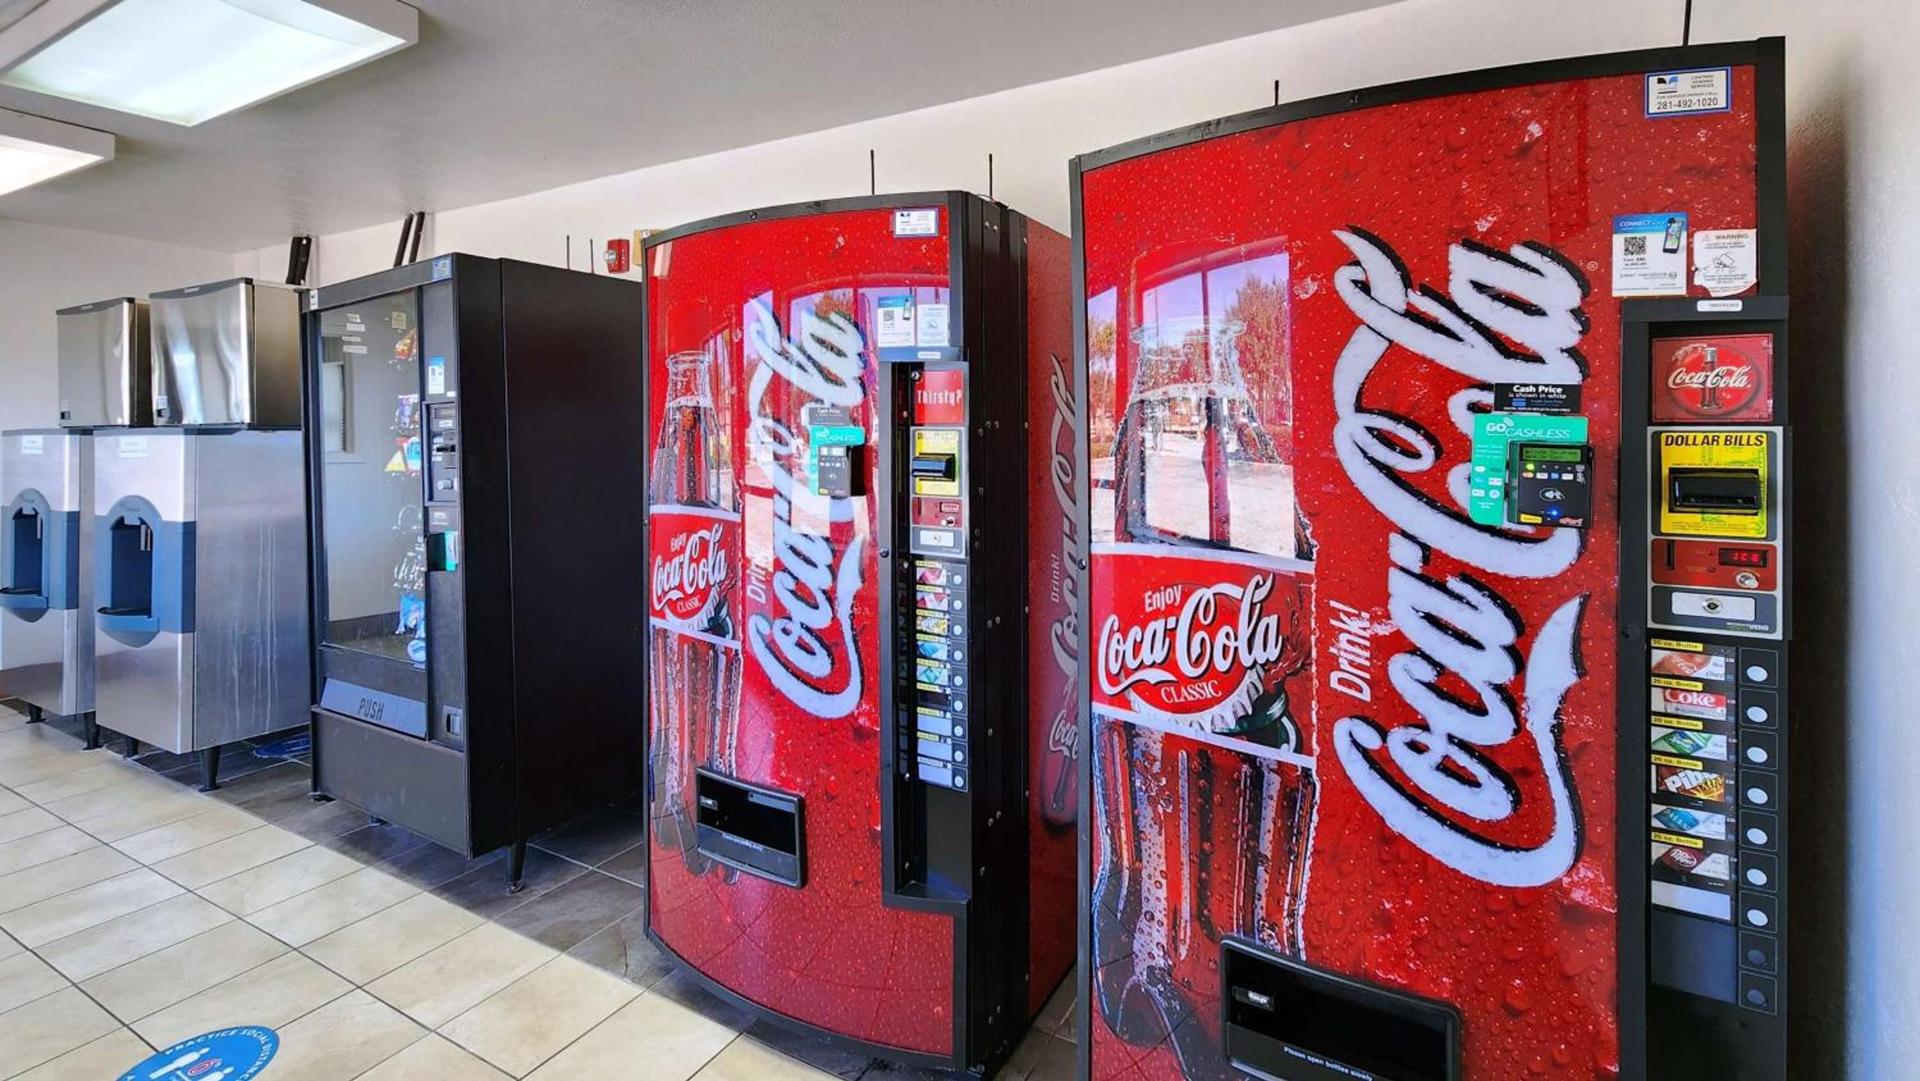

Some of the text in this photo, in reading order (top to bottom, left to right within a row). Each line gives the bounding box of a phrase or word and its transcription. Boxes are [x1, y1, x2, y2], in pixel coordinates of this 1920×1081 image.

[1656, 97, 1719, 110] 281-492-1020
[1667, 365, 1752, 389] Coca-Cola
[917, 389, 962, 407] Thirsty?
[1513, 385, 1563, 394] Cash Price
[1486, 422, 1570, 439] GO CASHLESS
[1665, 435, 1764, 447] DOLLAR BILLS
[653, 522, 727, 611] Coca-Cola
[1051, 553, 1060, 603] Drink!
[1144, 585, 1182, 613] Enjoy
[1098, 572, 1282, 696] Coca-Cola
[1329, 599, 1371, 702] Drink!
[1160, 680, 1222, 704] CLASSIC
[1664, 688, 1716, 708] Coke
[358, 697, 385, 721] PUSH
[165, 1029, 238, 1056] PRACTICE
[241, 1029, 268, 1045] SOCIAL
[1283, 1046, 1373, 1081] Please open bottles slowly
